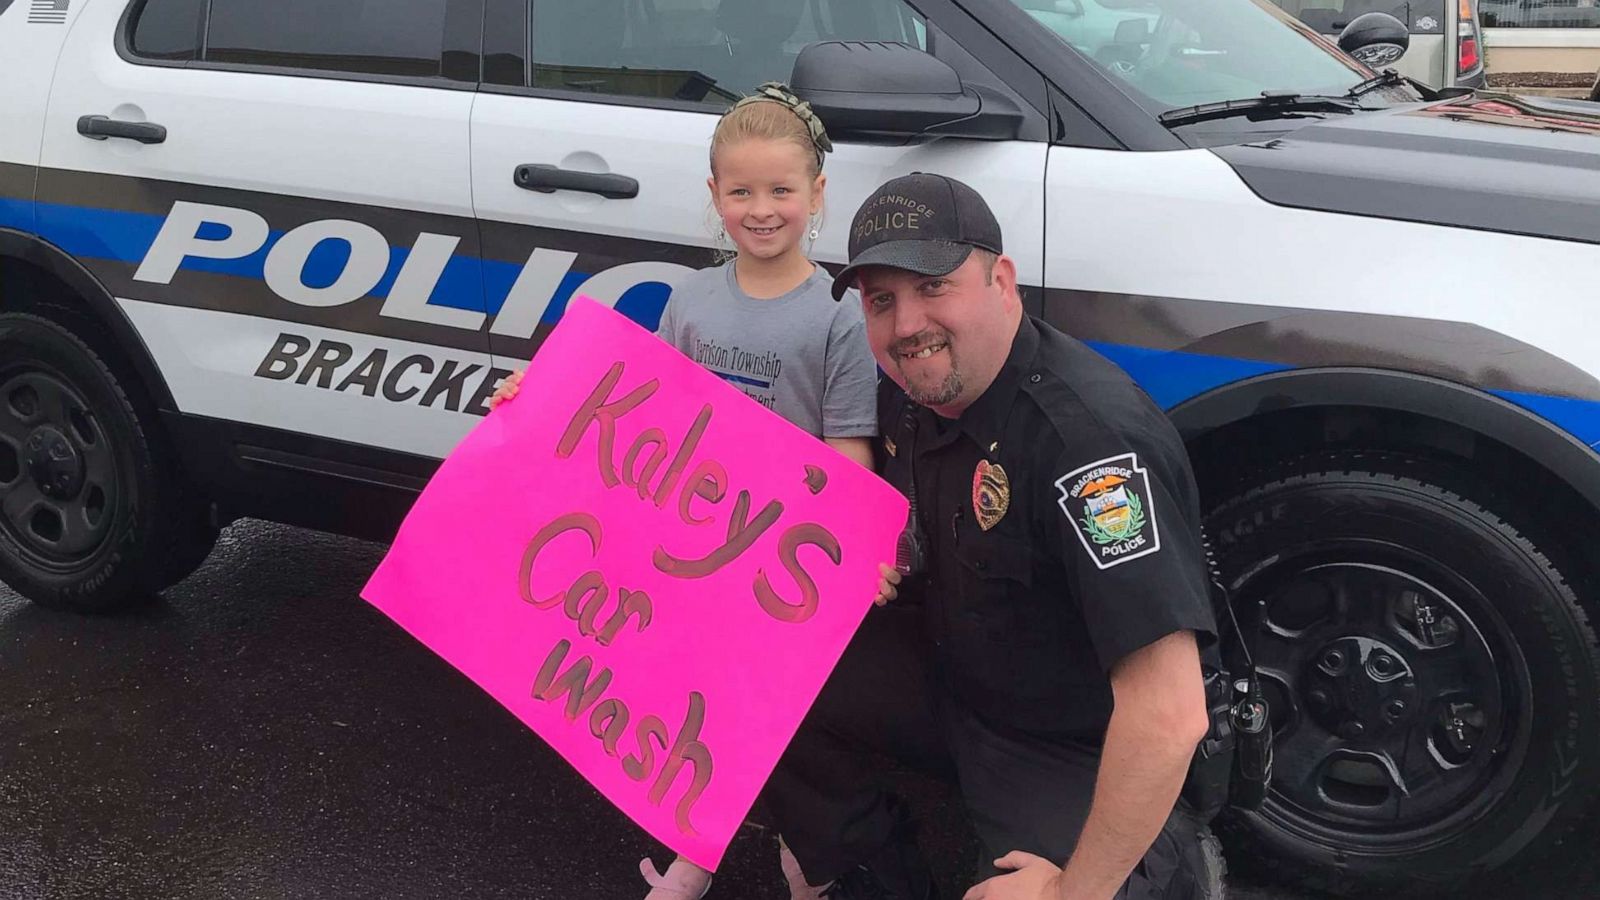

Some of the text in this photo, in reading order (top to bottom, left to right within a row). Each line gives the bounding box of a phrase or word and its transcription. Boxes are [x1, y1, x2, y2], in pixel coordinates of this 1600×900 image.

[857, 211, 919, 244] POLICE
[731, 345, 782, 387] Township
[555, 361, 842, 624] Kaley's
[1070, 466, 1134, 498] BRACKENRIDGE
[1101, 534, 1147, 557] POLICE
[518, 511, 653, 647] Car
[531, 638, 714, 837] Wash
